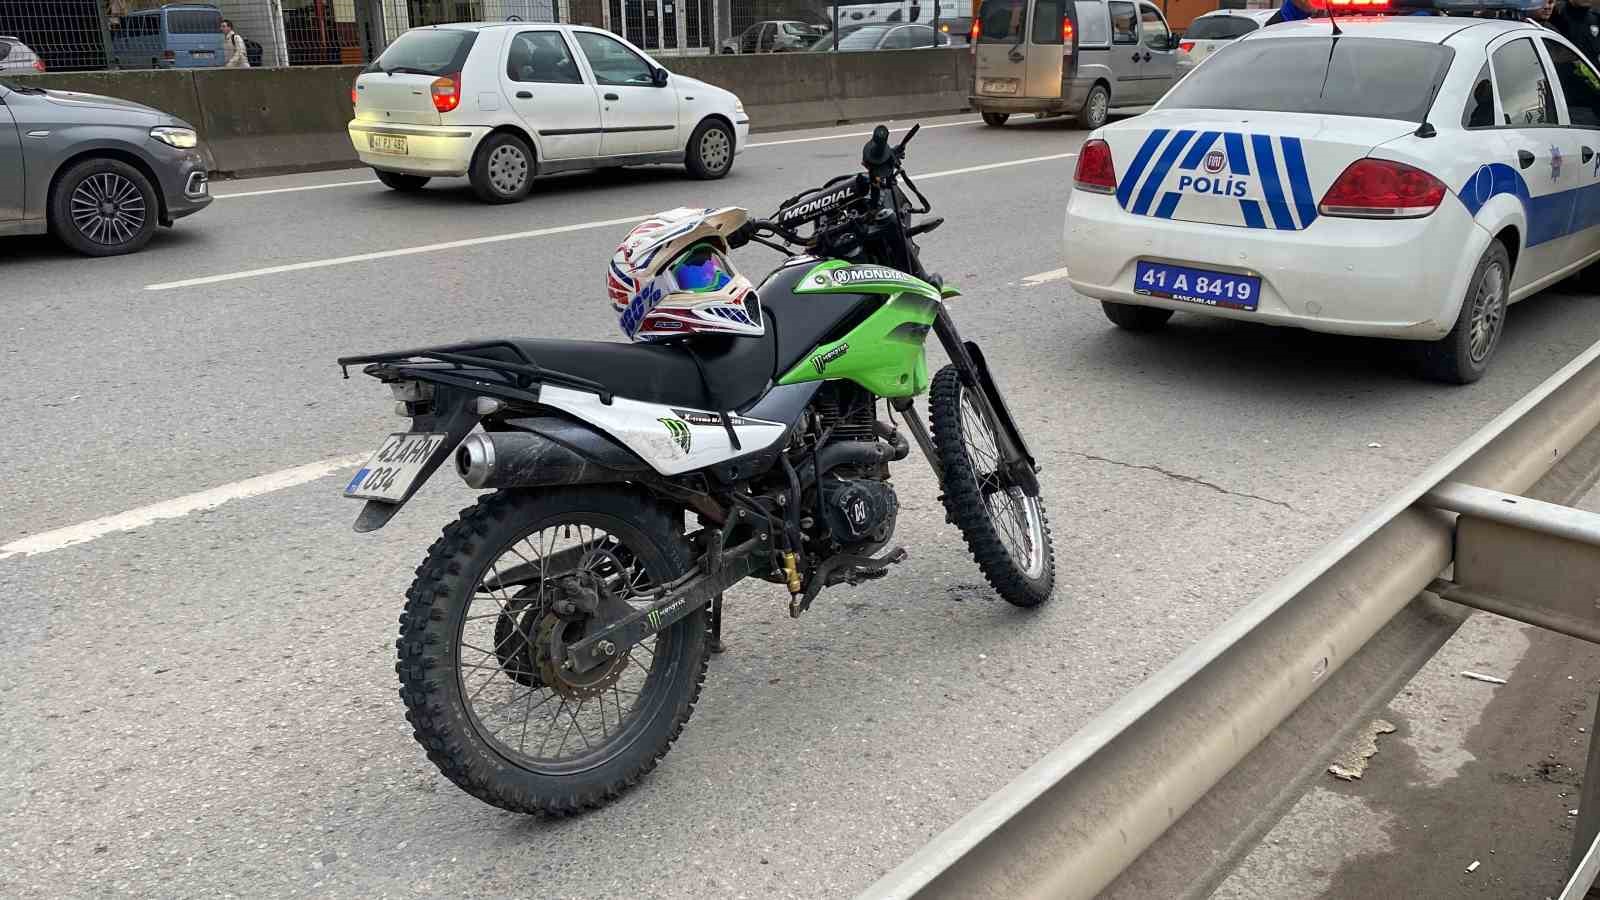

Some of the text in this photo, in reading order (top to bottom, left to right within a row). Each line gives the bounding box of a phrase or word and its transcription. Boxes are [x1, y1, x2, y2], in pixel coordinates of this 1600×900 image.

[1207, 155, 1223, 168] FIAT
[1179, 175, 1247, 197] POLİS
[783, 187, 855, 221] MONDIAL
[1142, 269, 1251, 300] 41 A 8419
[363, 466, 401, 492] 034
